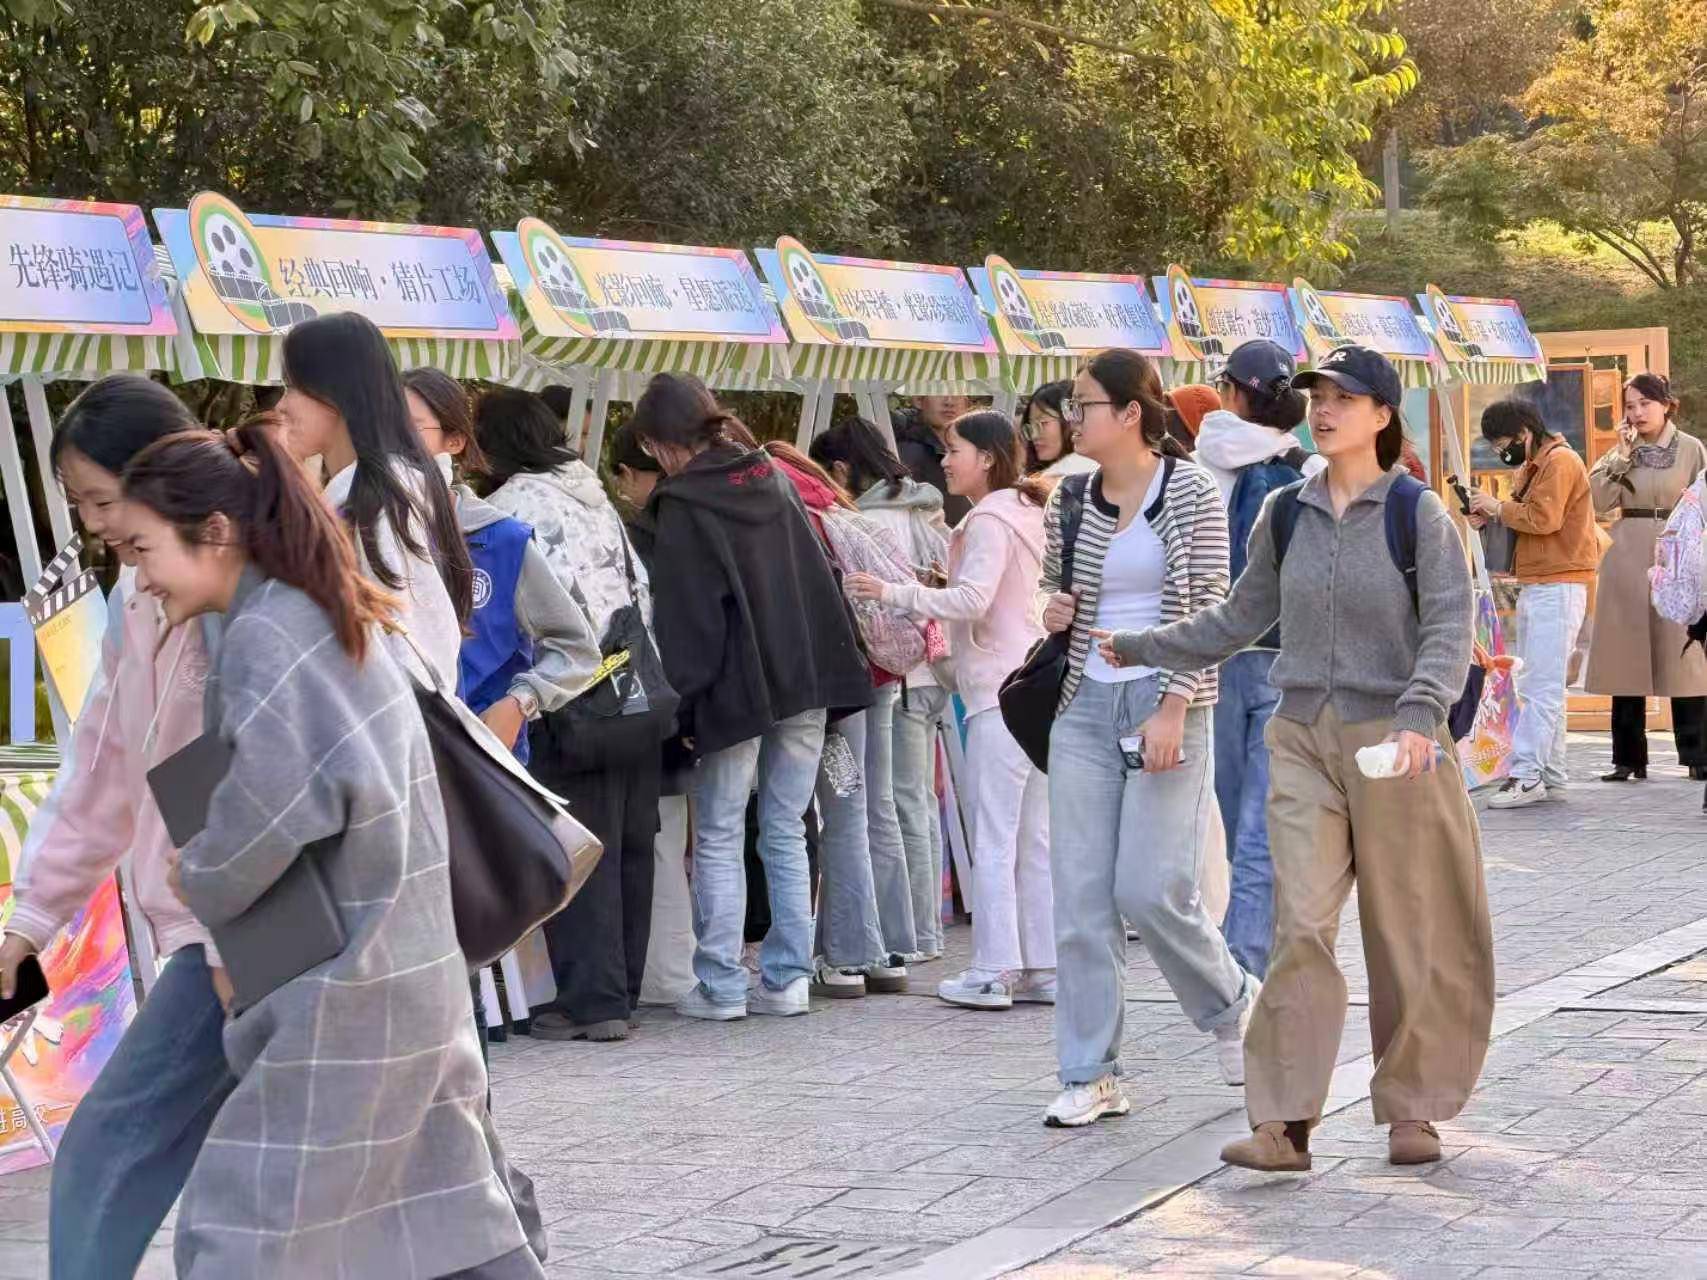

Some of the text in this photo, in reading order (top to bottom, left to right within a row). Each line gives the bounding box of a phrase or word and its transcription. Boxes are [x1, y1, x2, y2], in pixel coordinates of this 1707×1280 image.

[9, 243, 138, 291] 先锋骑遇记
[279, 256, 482, 303] 经典回响·猜片工场
